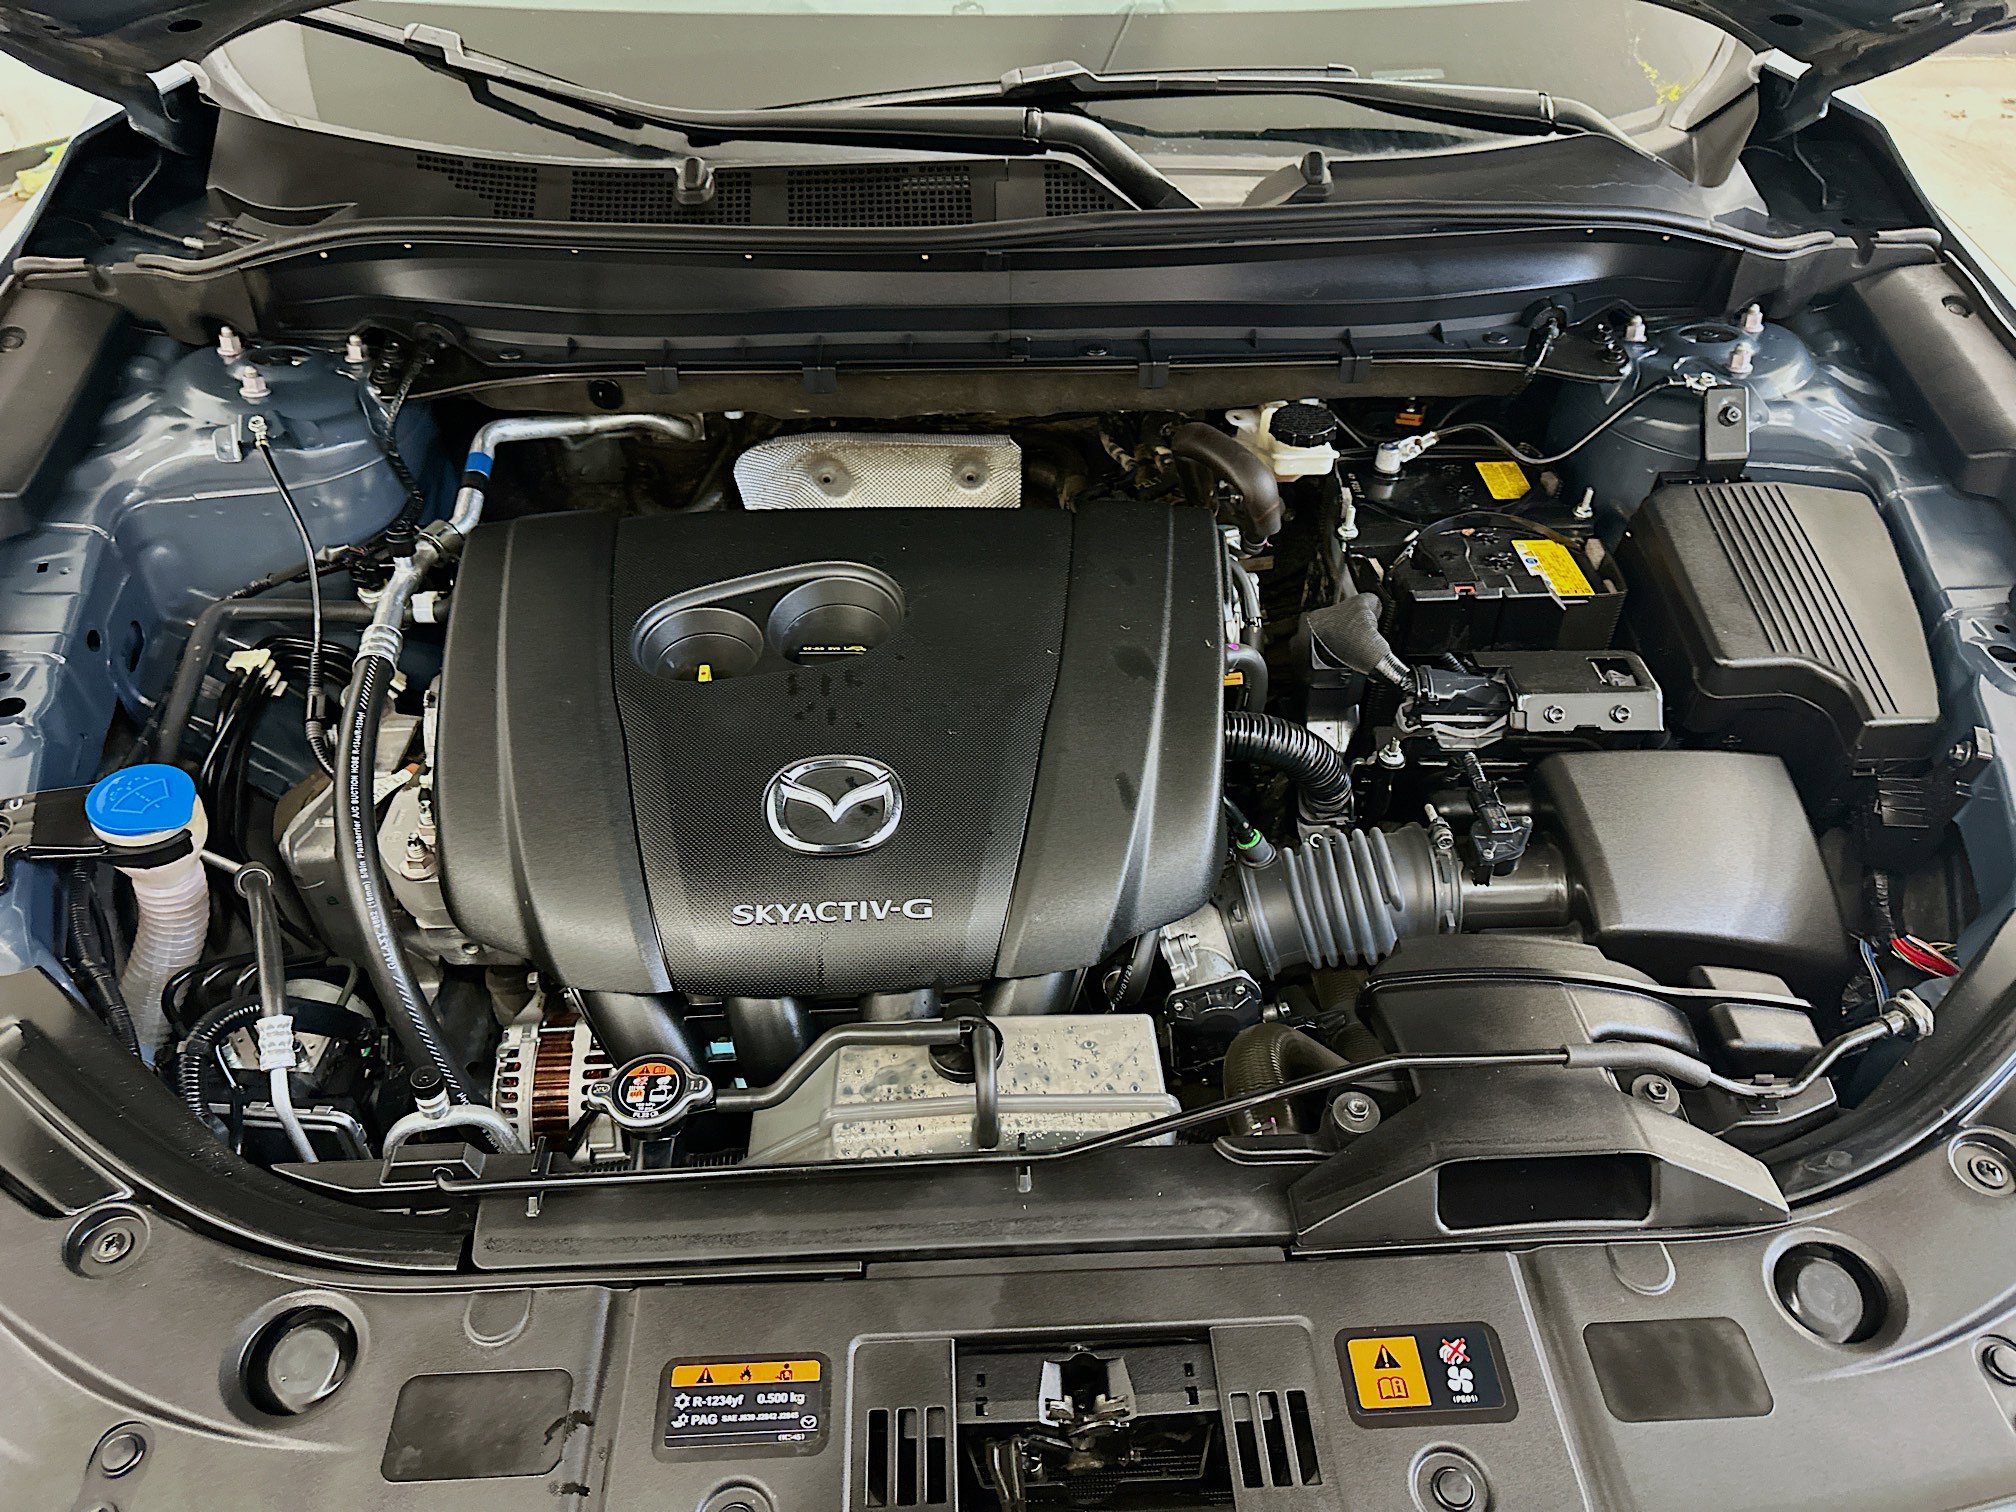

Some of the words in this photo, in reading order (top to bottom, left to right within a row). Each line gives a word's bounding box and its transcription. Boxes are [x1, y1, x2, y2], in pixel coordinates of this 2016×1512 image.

[351, 756, 359, 774] HOSE
[351, 775, 359, 805] SUCTION
[351, 806, 360, 818] A/C
[731, 898, 933, 927] SKYACTIV-G
[376, 932, 396, 969] GALAXY
[693, 1394, 744, 1407] R-1234yf
[757, 1392, 788, 1404] 0.500
[790, 1392, 805, 1404] kg
[691, 1414, 718, 1425] PAG
